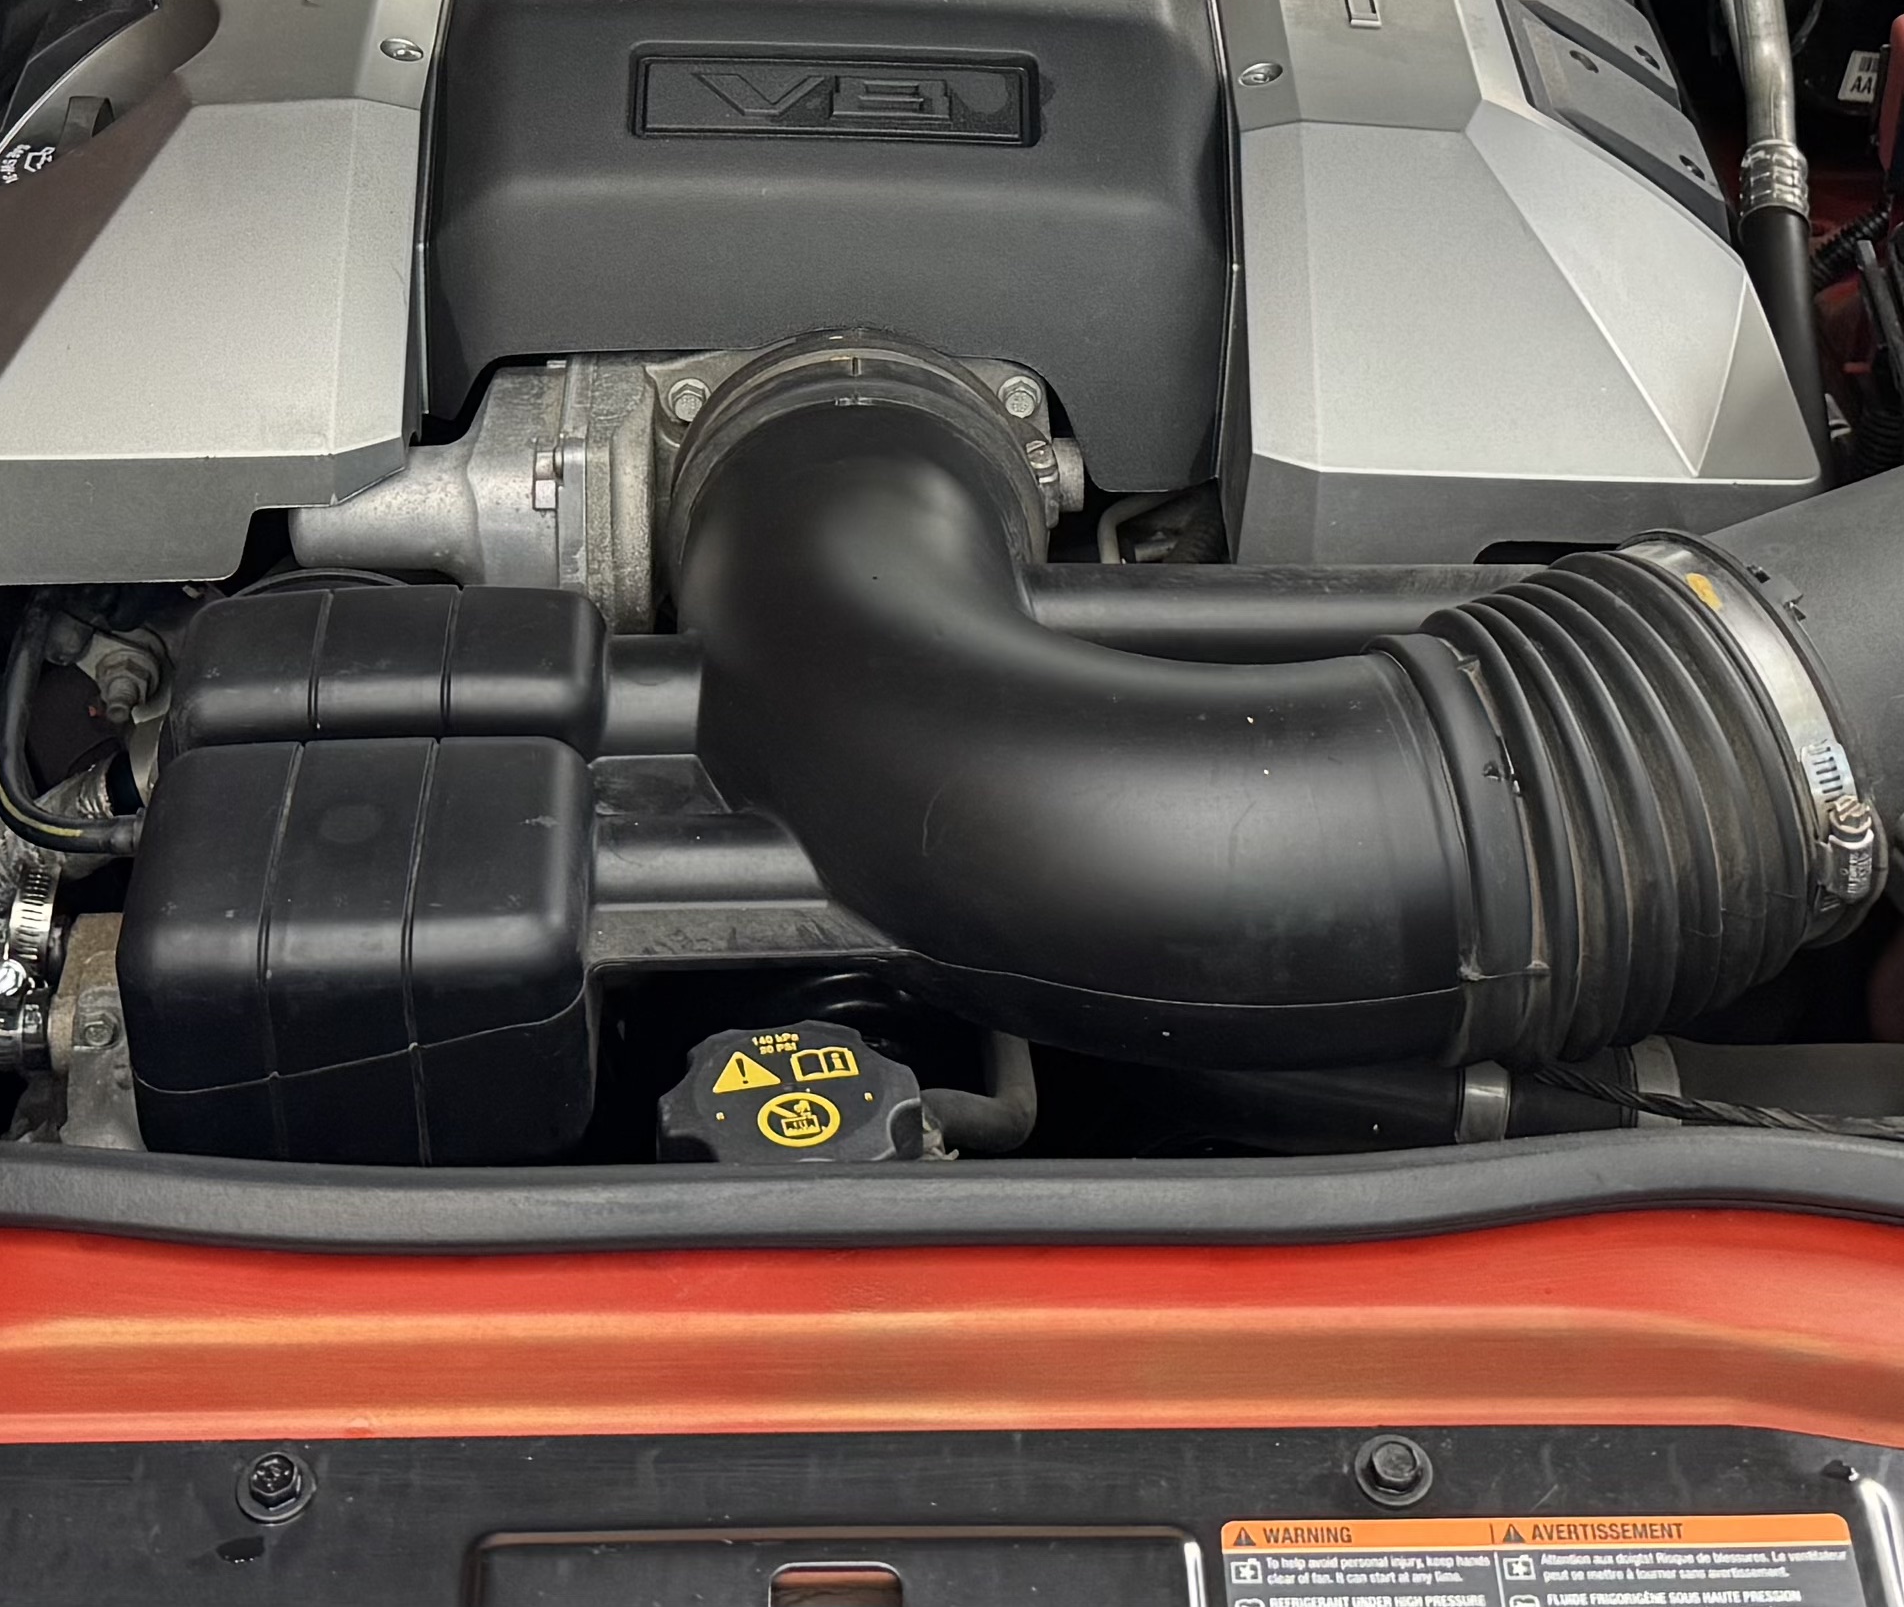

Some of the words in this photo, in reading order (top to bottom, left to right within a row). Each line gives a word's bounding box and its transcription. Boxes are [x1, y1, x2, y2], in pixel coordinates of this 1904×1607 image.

[691, 71, 953, 123] V8
[1263, 1526, 1353, 1544] WARNING
[1531, 1522, 1684, 1541] AVERTISSEMENT
[1266, 1557, 1280, 1569] To
[1397, 1571, 1411, 1583] at
[1269, 1596, 1350, 1607] REFRIGERANT
[1351, 1595, 1393, 1607] UNDER
[1393, 1594, 1424, 1607] HIGH
[1424, 1593, 1487, 1607] PRESSURE
[1668, 1591, 1702, 1605] SOUS
[1702, 1590, 1742, 1604] HAUTE
[1742, 1589, 1803, 1603] PRESSION
